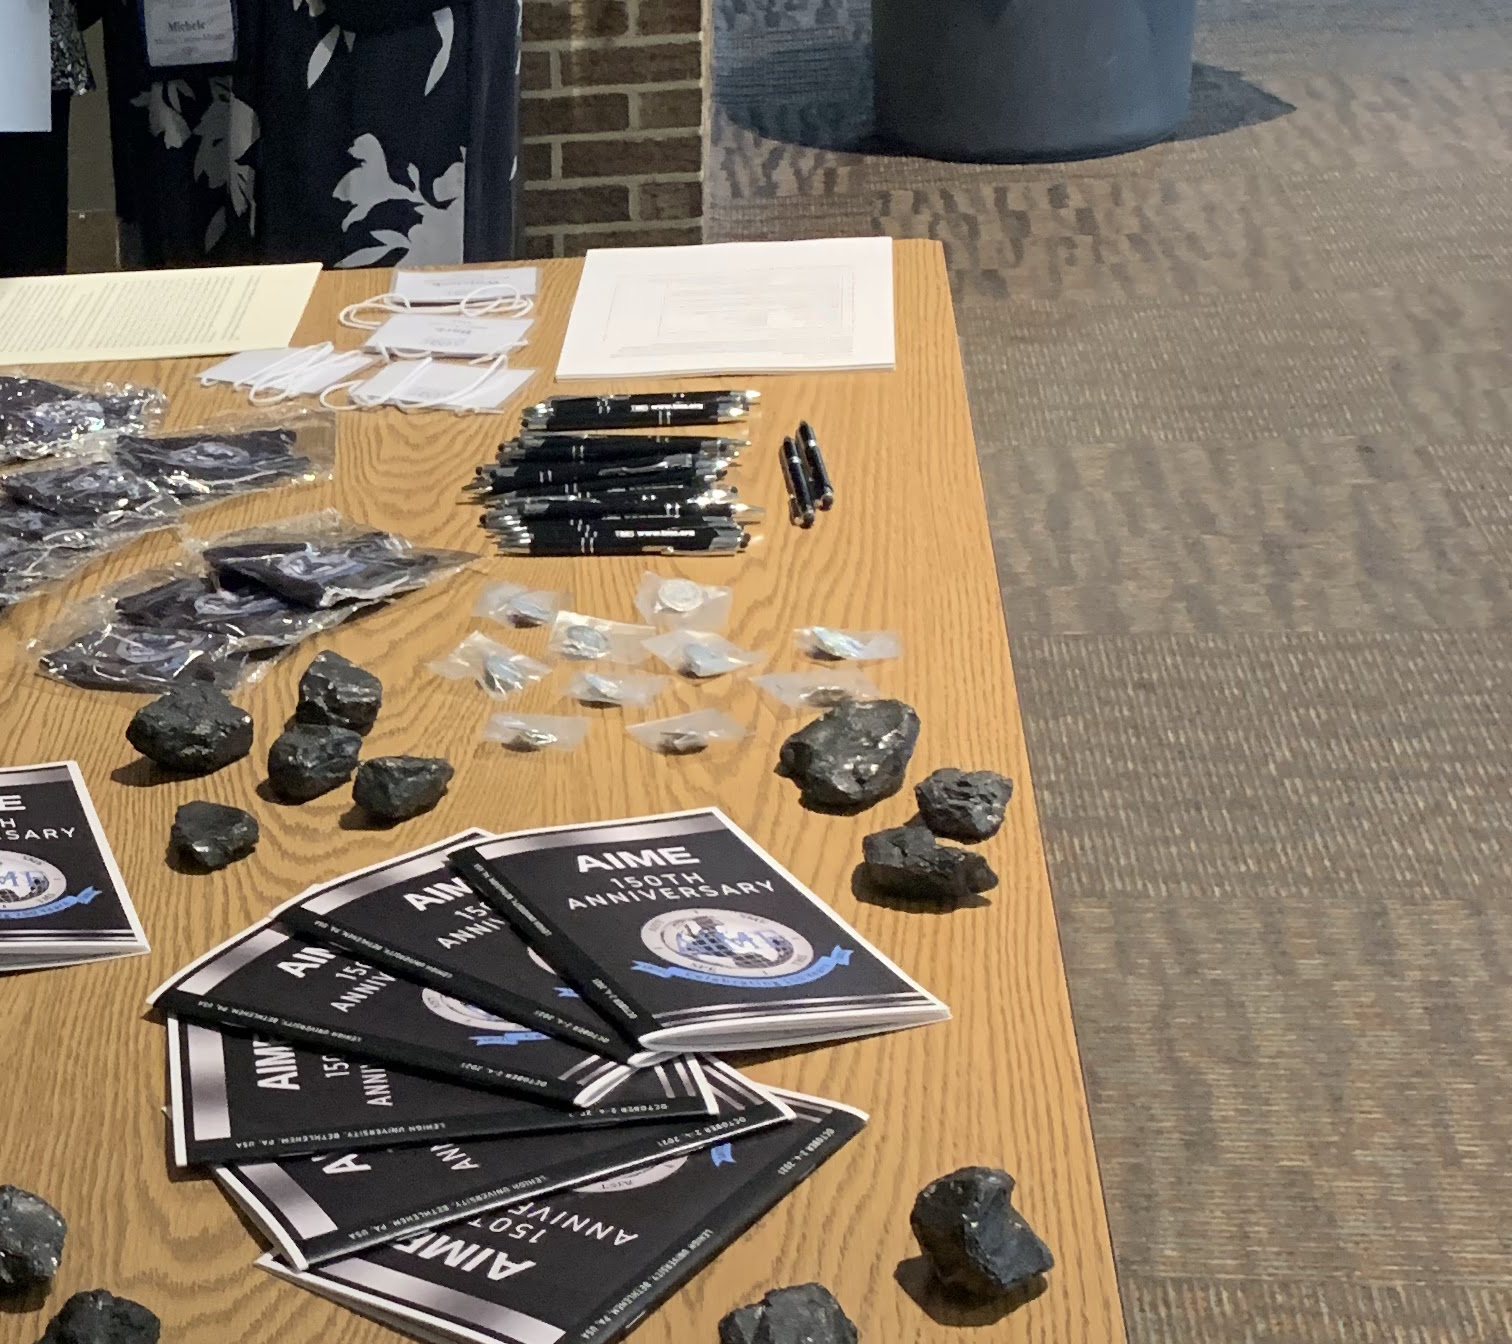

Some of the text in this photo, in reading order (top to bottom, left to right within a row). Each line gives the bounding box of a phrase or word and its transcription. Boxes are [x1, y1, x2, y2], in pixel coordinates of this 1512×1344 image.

[167, 19, 205, 33] Michele
[576, 845, 701, 873] AIME
[610, 870, 705, 890] 150TH
[568, 879, 775, 911] ANNIVERSARY
[619, 1102, 668, 1113] OCTOBER
[406, 1121, 446, 1132] LEHIGH
[702, 1115, 748, 1134] OCTOBER
[234, 1140, 256, 1149] USA
[655, 1132, 681, 1147] 2021
[804, 1125, 837, 1153] OCTOBER
[774, 1157, 796, 1177] 2021
[509, 1173, 548, 1191] LEHIGH
[346, 1227, 370, 1240] USA
[687, 1226, 716, 1253] LEHIGH
[578, 1321, 600, 1341] USA
